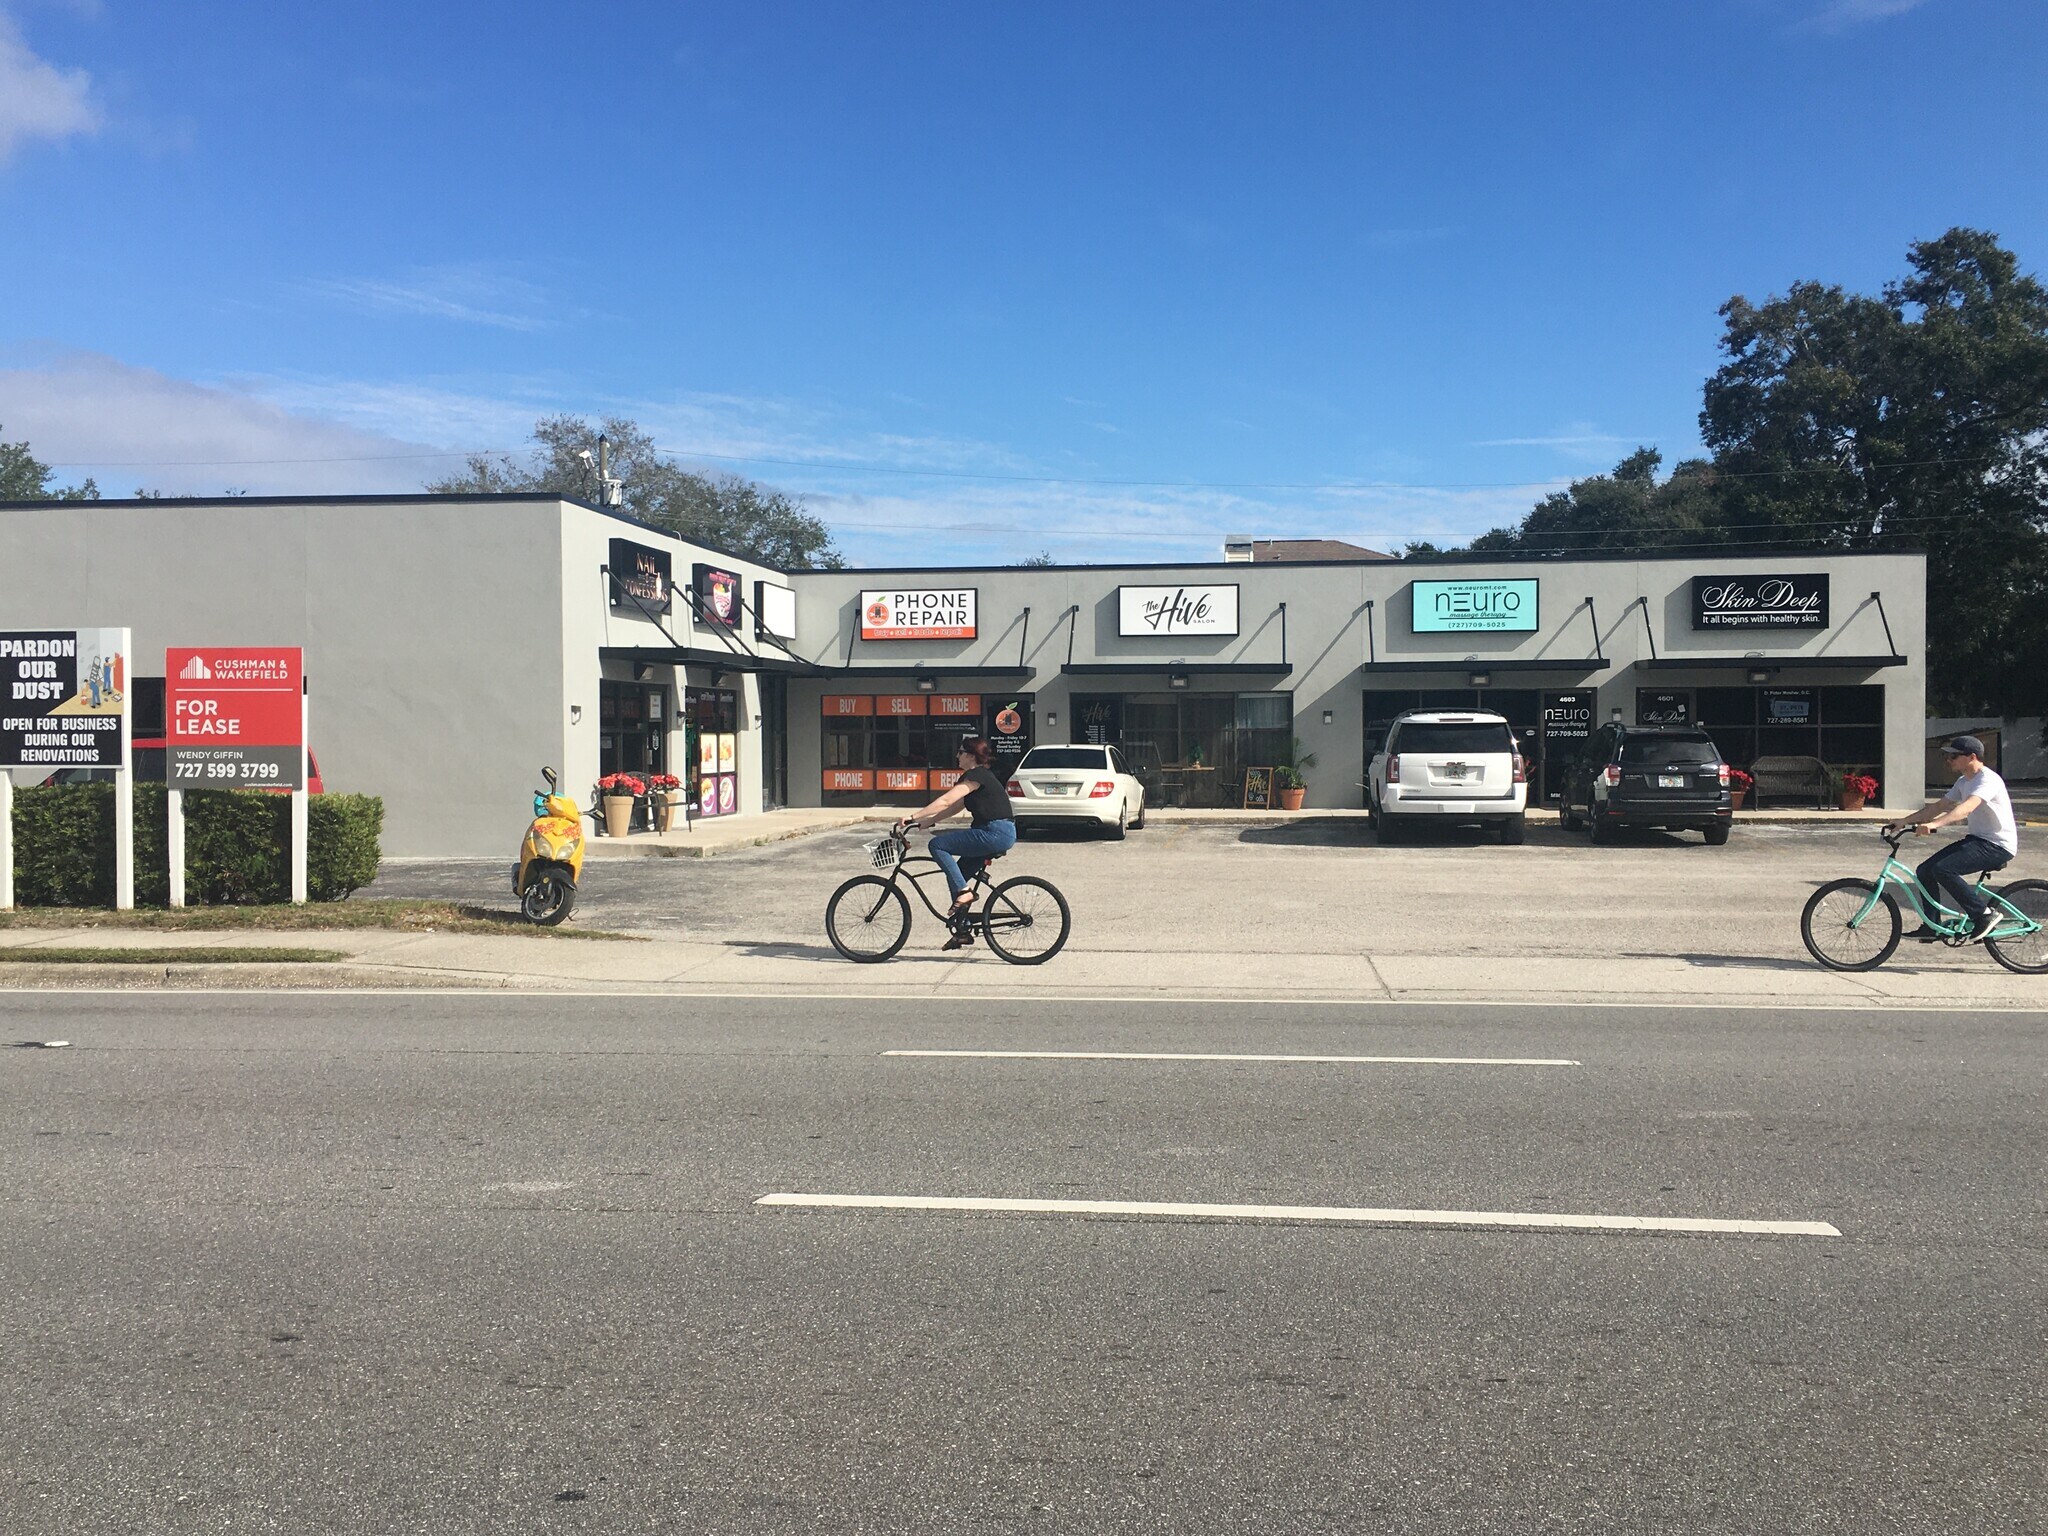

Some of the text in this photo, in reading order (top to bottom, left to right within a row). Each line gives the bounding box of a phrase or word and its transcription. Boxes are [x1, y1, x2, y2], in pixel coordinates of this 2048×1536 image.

[636, 553, 657, 575] NAIL
[895, 593, 967, 608] PHONE
[1702, 580, 1821, 612] Skin Deep
[896, 611, 967, 625] REPAIR
[1480, 611, 1507, 619] therapy
[1722, 615, 1749, 625] begins
[1751, 614, 1768, 622] with
[1770, 614, 1800, 624] healthy
[941, 627, 963, 637] repair
[0, 640, 75, 657] PARDON
[19, 661, 57, 678] OUR
[215, 660, 287, 669] CUSHMAN &
[215, 670, 288, 679] WAKEFIELD
[12, 682, 64, 699] DUST
[176, 700, 217, 715] FOR
[840, 699, 857, 713] BUY
[892, 699, 912, 713] SELL
[942, 698, 969, 713] TRADE
[3, 718, 117, 731] OPEN FOR BUSINESS
[176, 719, 240, 734] LEASE
[25, 734, 95, 746] DURING OUR
[21, 750, 99, 762] RENOVATIONS
[175, 763, 279, 778] 727 599 3799
[835, 773, 863, 787] PHONE
[887, 773, 917, 787] TABLET
